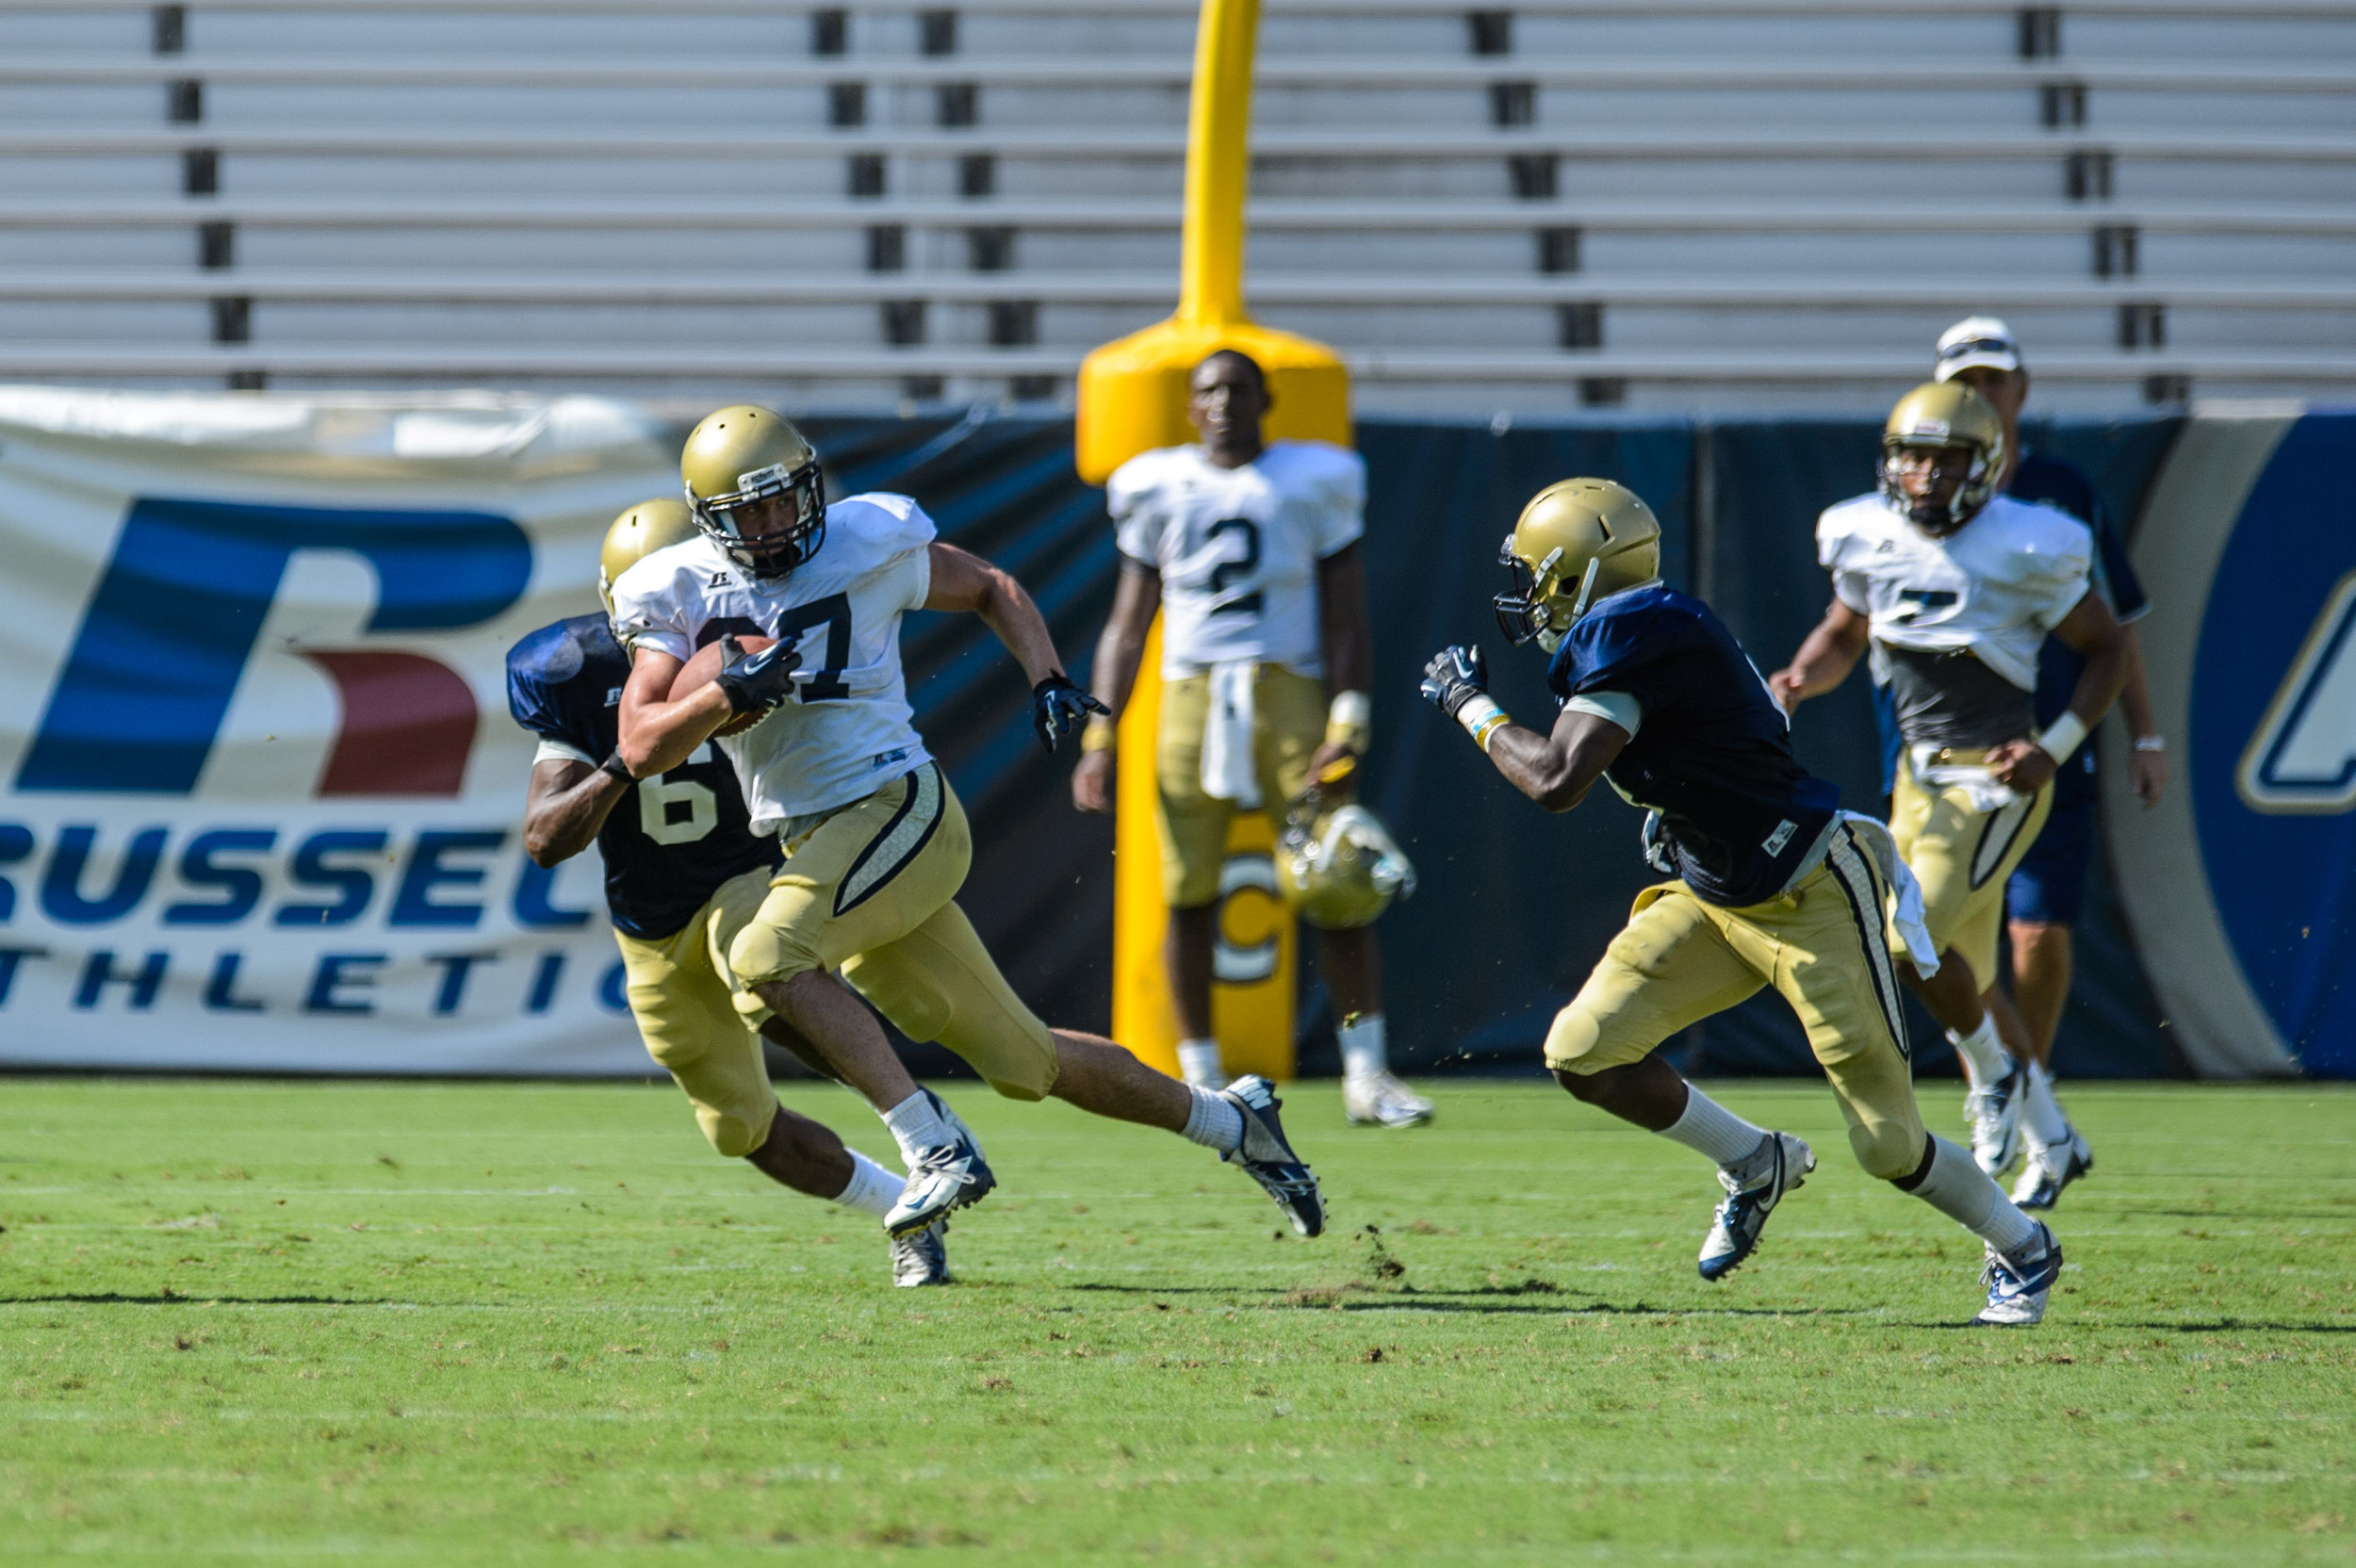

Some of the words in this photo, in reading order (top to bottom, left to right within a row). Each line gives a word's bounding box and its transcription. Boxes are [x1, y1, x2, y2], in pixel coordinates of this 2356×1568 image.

[1207, 517, 1264, 616] 2
[695, 592, 852, 703] 7
[638, 741, 718, 845] 6
